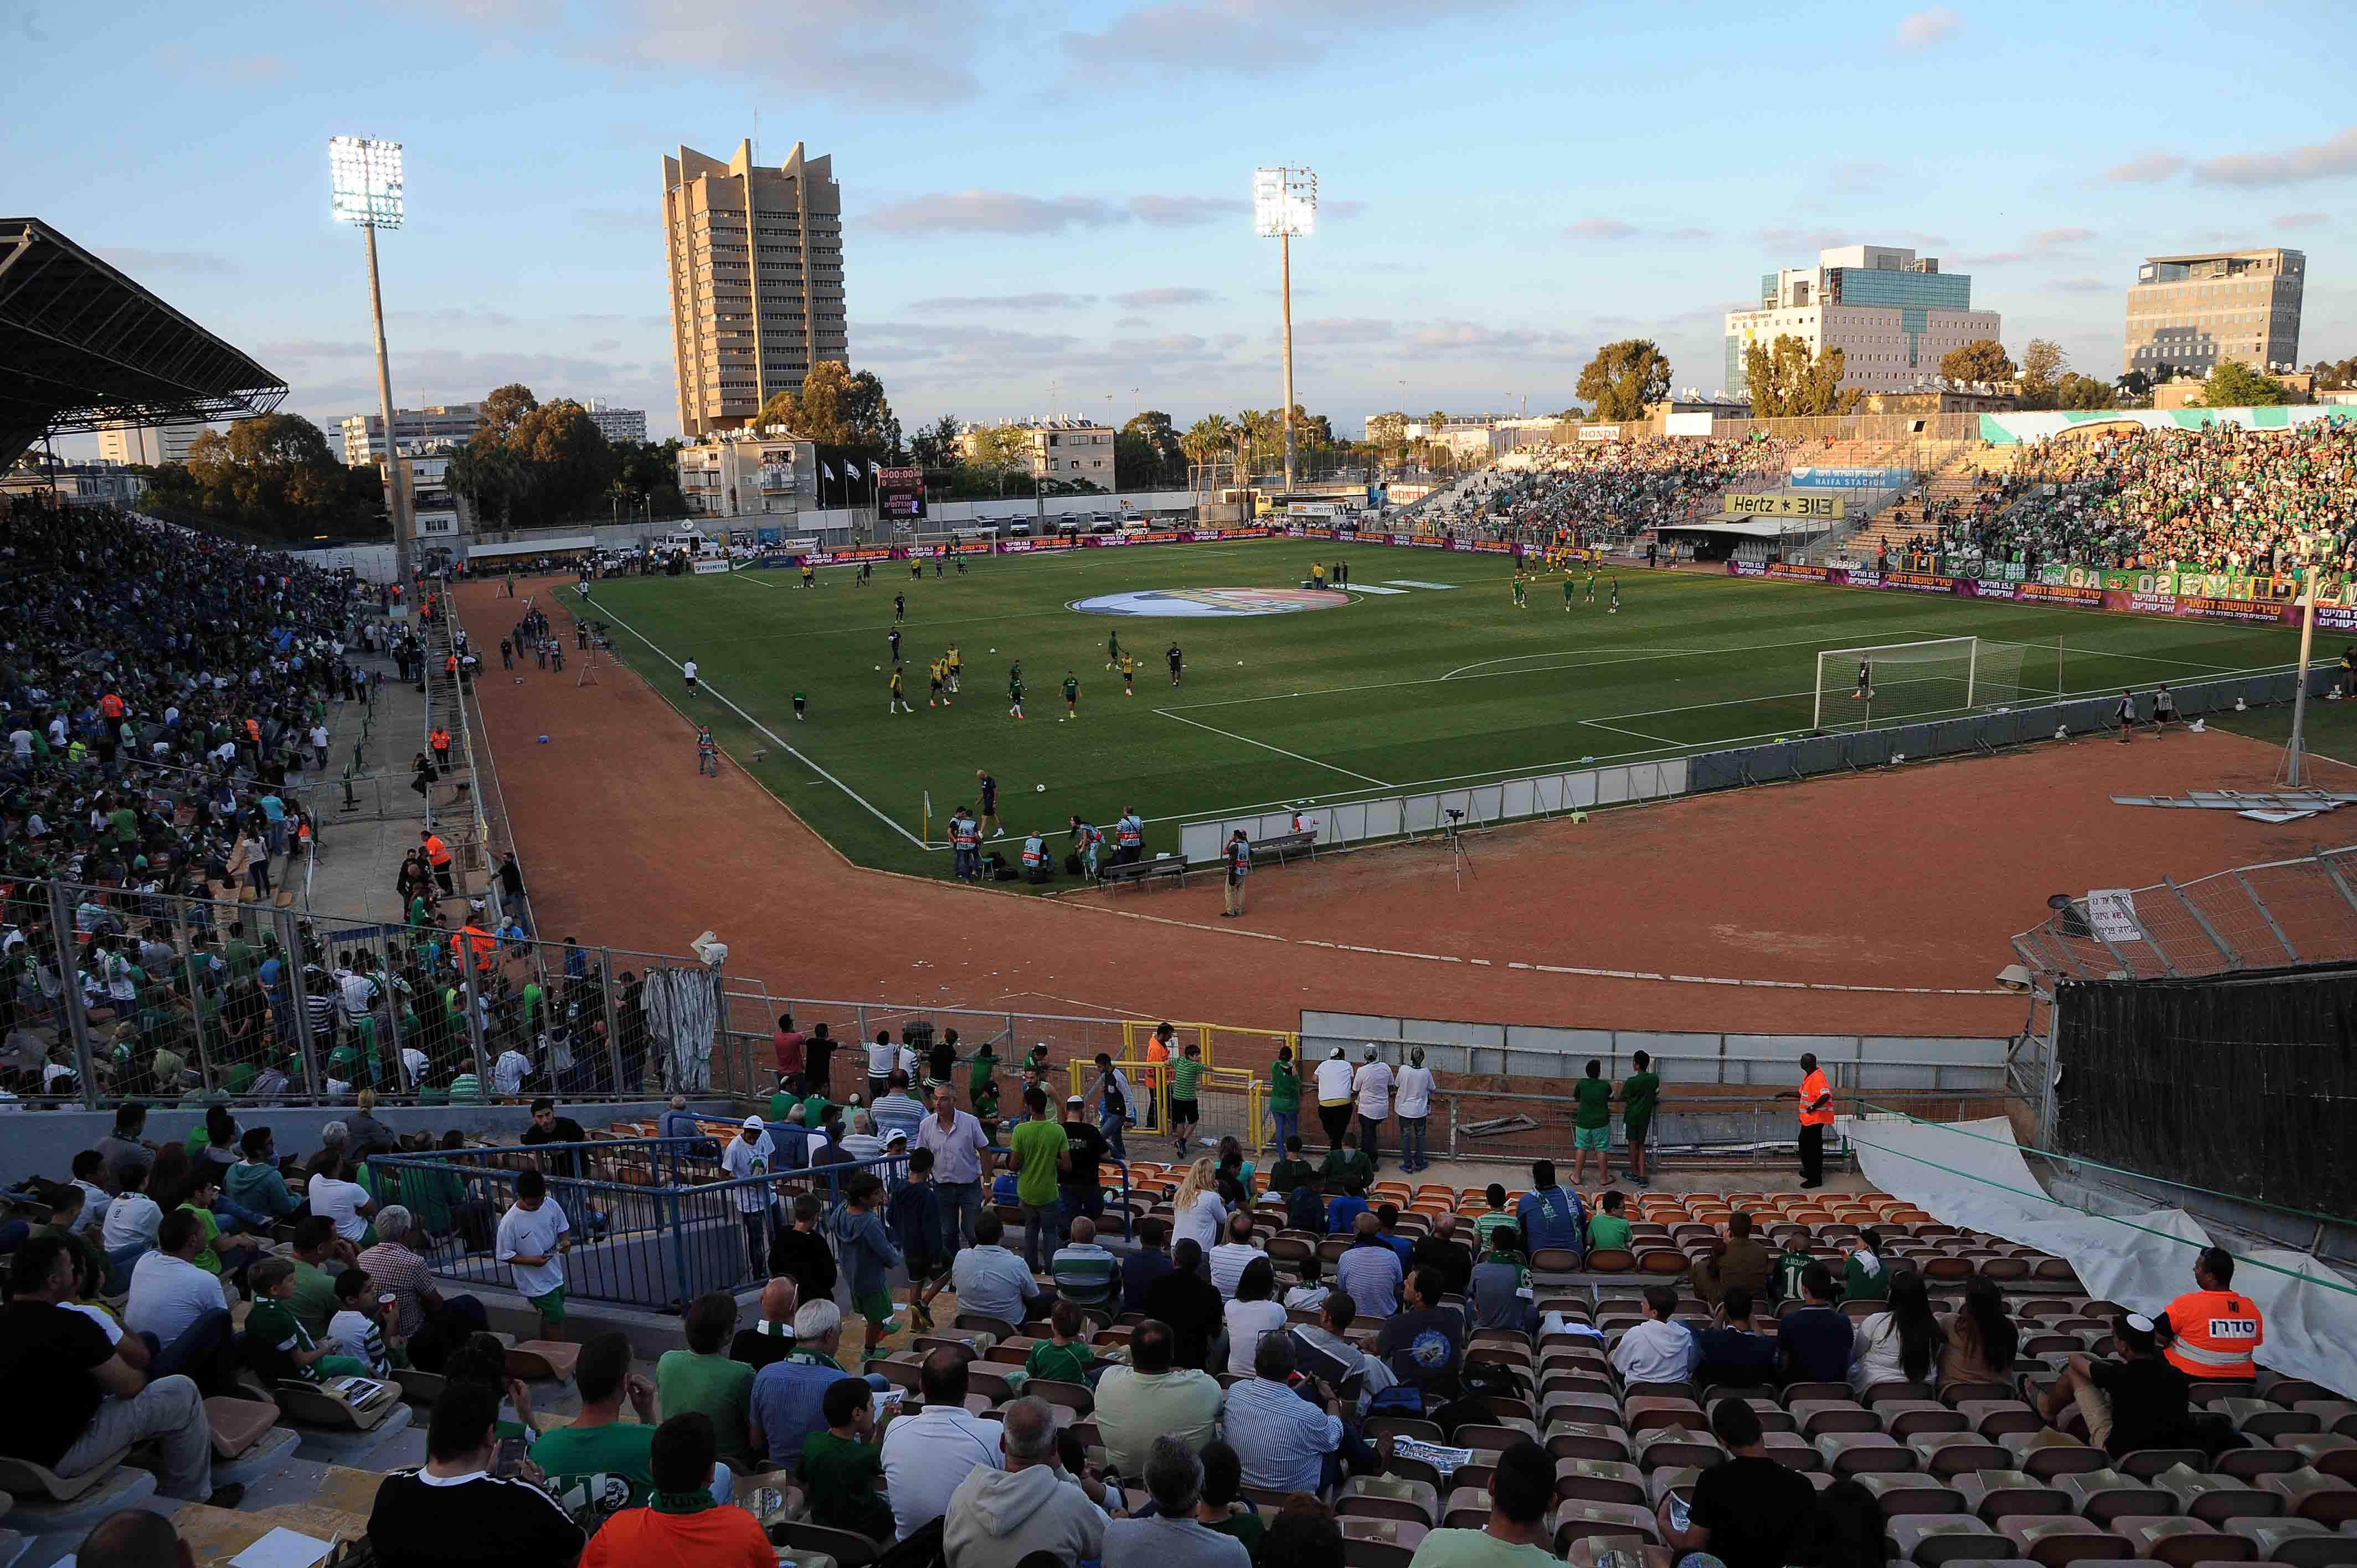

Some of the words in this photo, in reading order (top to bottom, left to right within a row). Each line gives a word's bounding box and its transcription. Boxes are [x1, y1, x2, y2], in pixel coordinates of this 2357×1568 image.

[889, 470, 913, 478] 00:00
[1734, 496, 1774, 512] Hertz
[2005, 571, 2025, 579] 2013
[1978, 580, 2000, 589] חמישי
[2020, 584, 2047, 594] דמארי
[1978, 587, 2014, 598] אודיטוריום
[2048, 586, 2079, 597] שושנה
[2082, 589, 2101, 600] שירי
[2132, 593, 2158, 602] חמישי
[2132, 602, 2175, 612] אודיטוריום
[2184, 598, 2216, 610] דמארי
[2217, 601, 2254, 612] שושנה
[2257, 604, 2281, 615] שירי
[2319, 608, 2351, 618] חמישי
[2319, 618, 2357, 628] דיטוריום
[2212, 1321, 2255, 1335] סדרן
